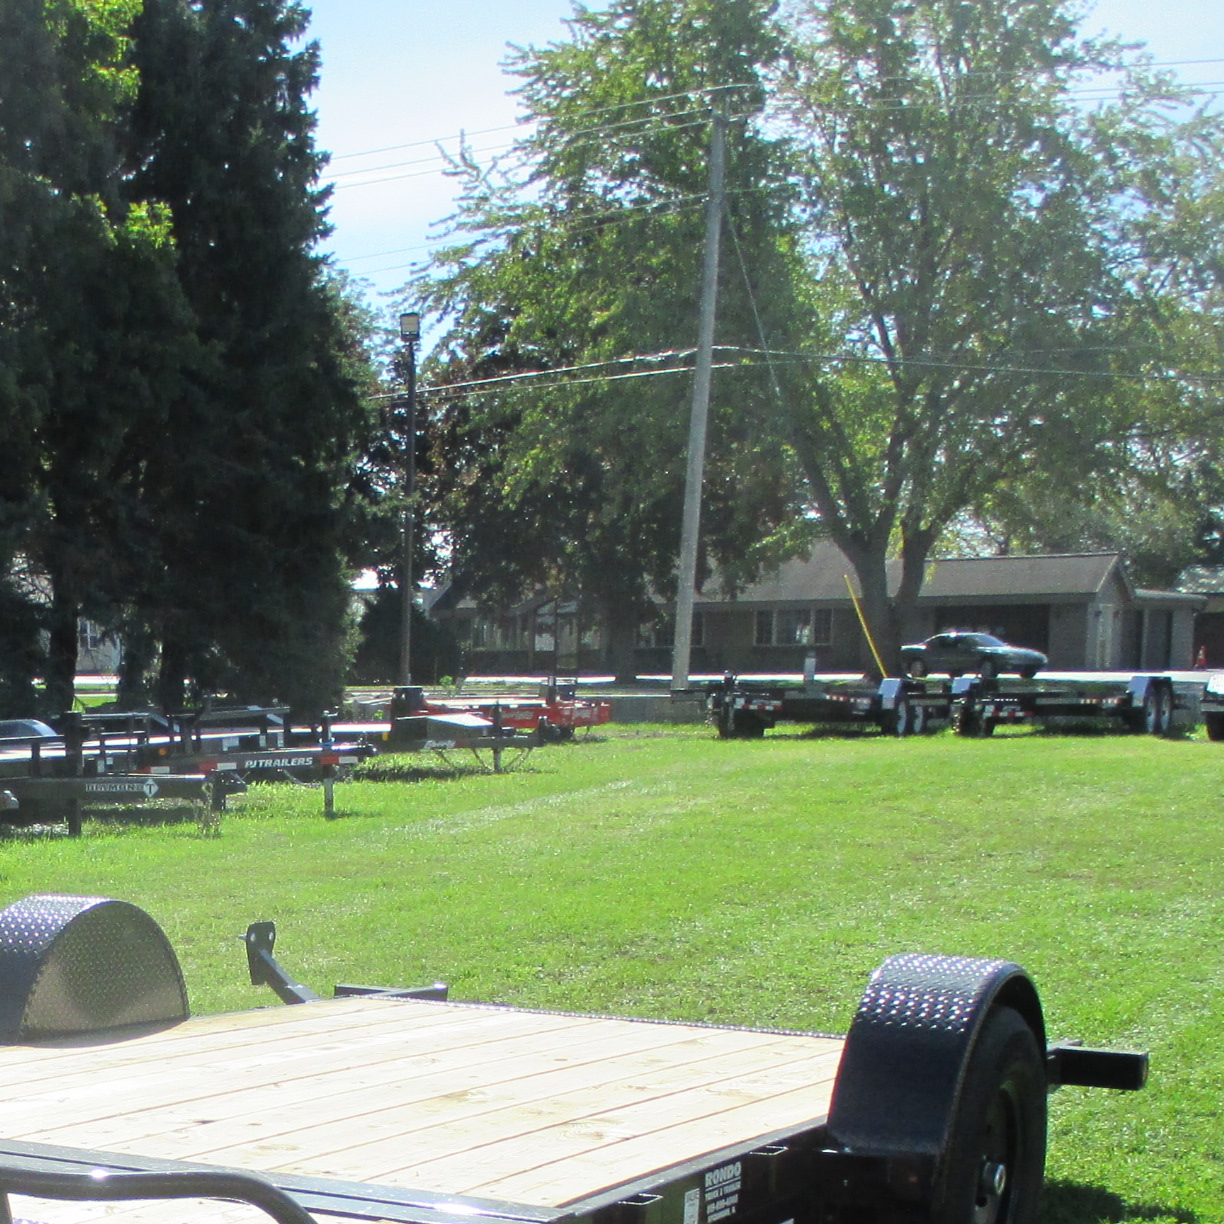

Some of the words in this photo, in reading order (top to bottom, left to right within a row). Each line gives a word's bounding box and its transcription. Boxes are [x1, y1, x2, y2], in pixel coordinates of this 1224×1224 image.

[244, 760, 258, 768] PJ
[258, 756, 313, 768] TRAILERS
[704, 1161, 742, 1188] RONDO
